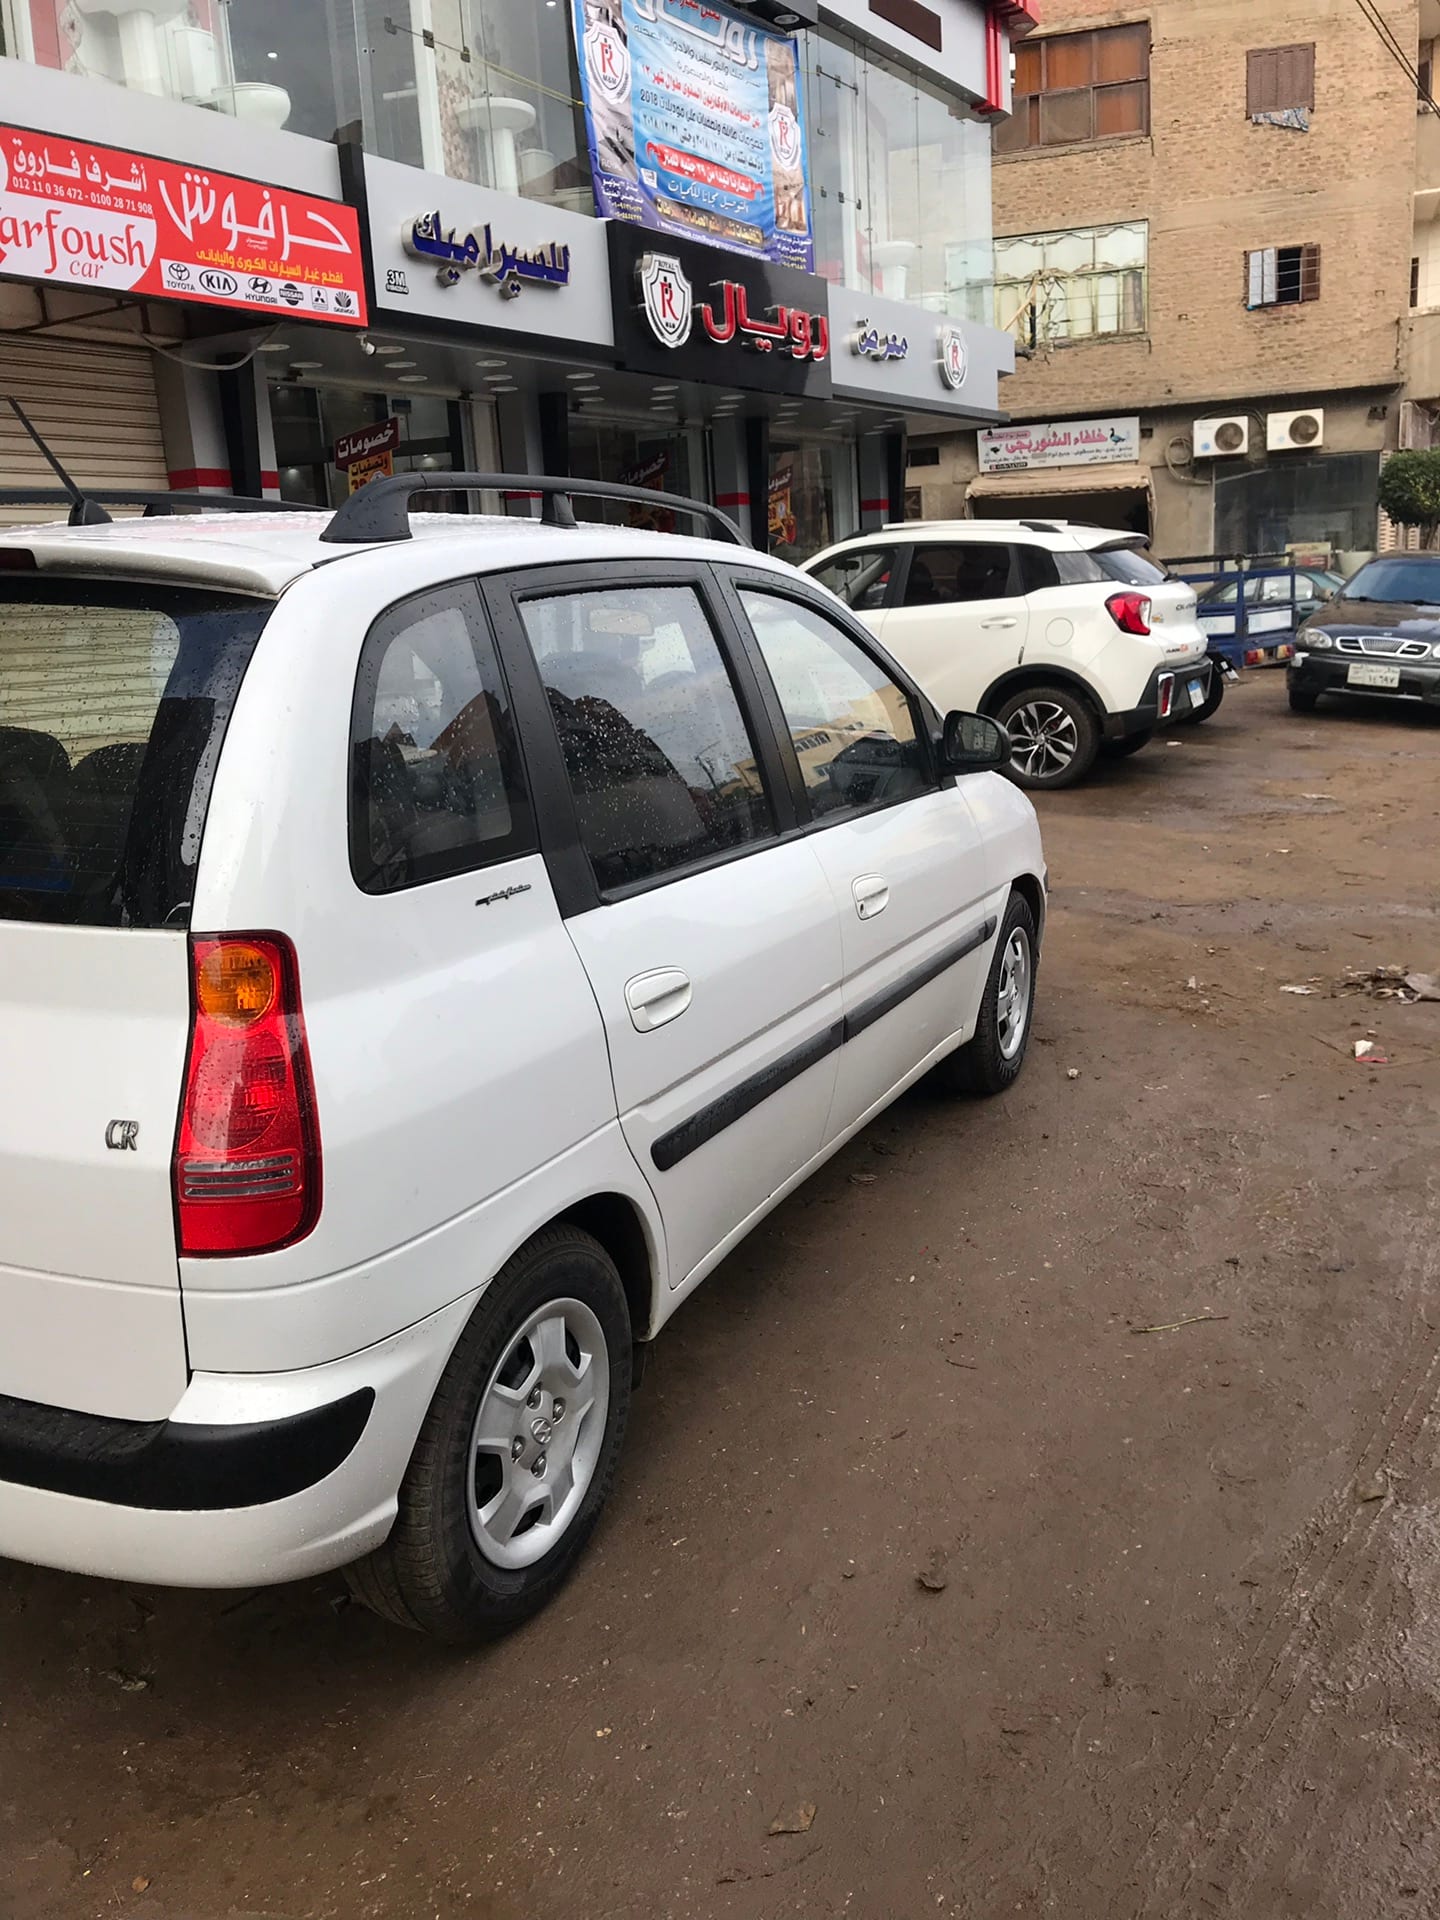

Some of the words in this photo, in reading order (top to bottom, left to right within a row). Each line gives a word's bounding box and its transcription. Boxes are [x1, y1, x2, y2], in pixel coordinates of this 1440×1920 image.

[640, 88, 659, 107] 2018
[12, 138, 81, 178] فاروق
[86, 154, 148, 192] أشرف
[12, 176, 30, 190] 012
[32, 180, 43, 193] 11
[45, 183, 51, 194] 0
[53, 184, 65, 197] 36
[66, 187, 83, 201] 472
[90, 192, 111, 207] 0100
[113, 196, 124, 209] 28
[125, 198, 136, 212] 71
[138, 201, 153, 215] 908
[158, 172, 352, 261] حرفوش
[0, 208, 148, 275] arfoush
[404, 210, 571, 300] للسيراميك
[657, 259, 677, 271] ROYAL
[69, 259, 104, 279] car
[268, 258, 302, 278] السيارات
[303, 266, 320, 284] غيار
[321, 272, 345, 285] لقطع
[386, 269, 406, 286] 3M
[166, 280, 196, 291] TOYOTA
[205, 273, 233, 291] KIA
[245, 292, 278, 305] HYUNDAI
[659, 276, 680, 321] R
[701, 280, 830, 361] رويال
[857, 317, 908, 361] معرض
[337, 423, 395, 459] خصومات
[1073, 428, 1108, 446] خلفاء
[351, 455, 388, 477] وتصفيات
